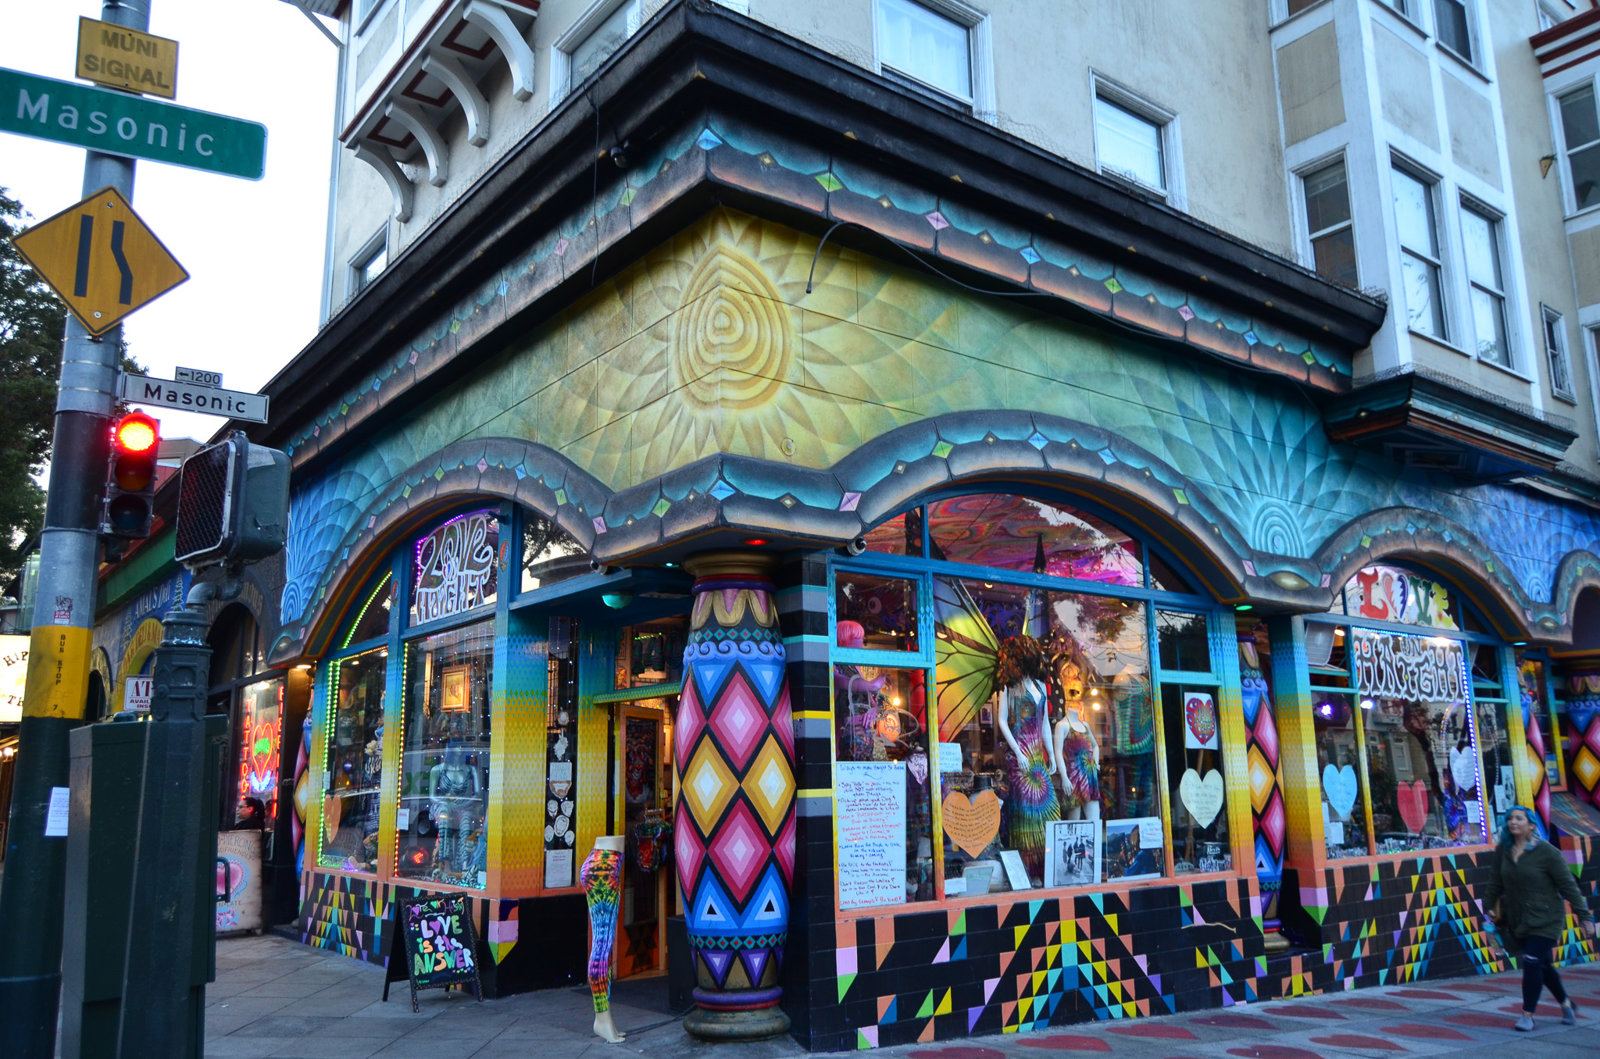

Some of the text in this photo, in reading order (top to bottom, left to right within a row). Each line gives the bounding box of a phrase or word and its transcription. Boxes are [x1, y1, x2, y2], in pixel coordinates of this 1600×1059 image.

[101, 29, 158, 59] MUNI
[84, 54, 170, 90] SIGNAL
[16, 89, 214, 157] Masonic
[190, 371, 221, 385] 1200
[144, 382, 246, 413] Masonic
[1356, 567, 1454, 628] LOVE
[1353, 633, 1466, 703] HAIGHT
[131, 680, 152, 697] AT
[239, 698, 252, 800] TATTOO
[420, 914, 463, 939] LOVE
[416, 937, 434, 954] is
[414, 947, 474, 977] ANSWER
